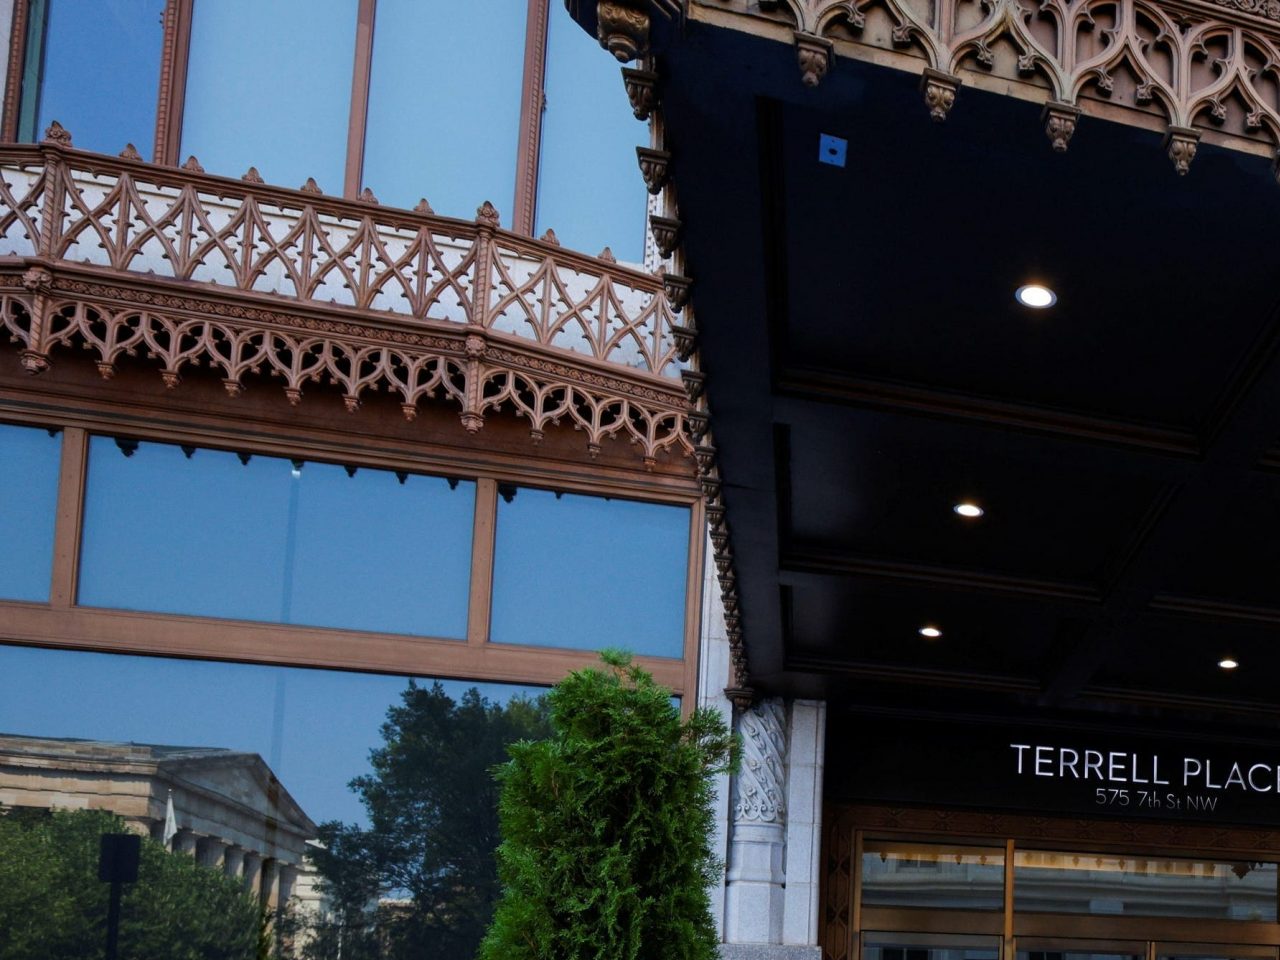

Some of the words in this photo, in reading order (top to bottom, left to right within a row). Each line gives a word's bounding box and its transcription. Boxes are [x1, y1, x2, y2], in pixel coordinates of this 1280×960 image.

[1010, 744, 1169, 784] TERRELL
[1095, 788, 1130, 806] 575
[1137, 790, 1160, 808] 7th
[1166, 793, 1181, 811] St
[1186, 795, 1218, 812] NW
